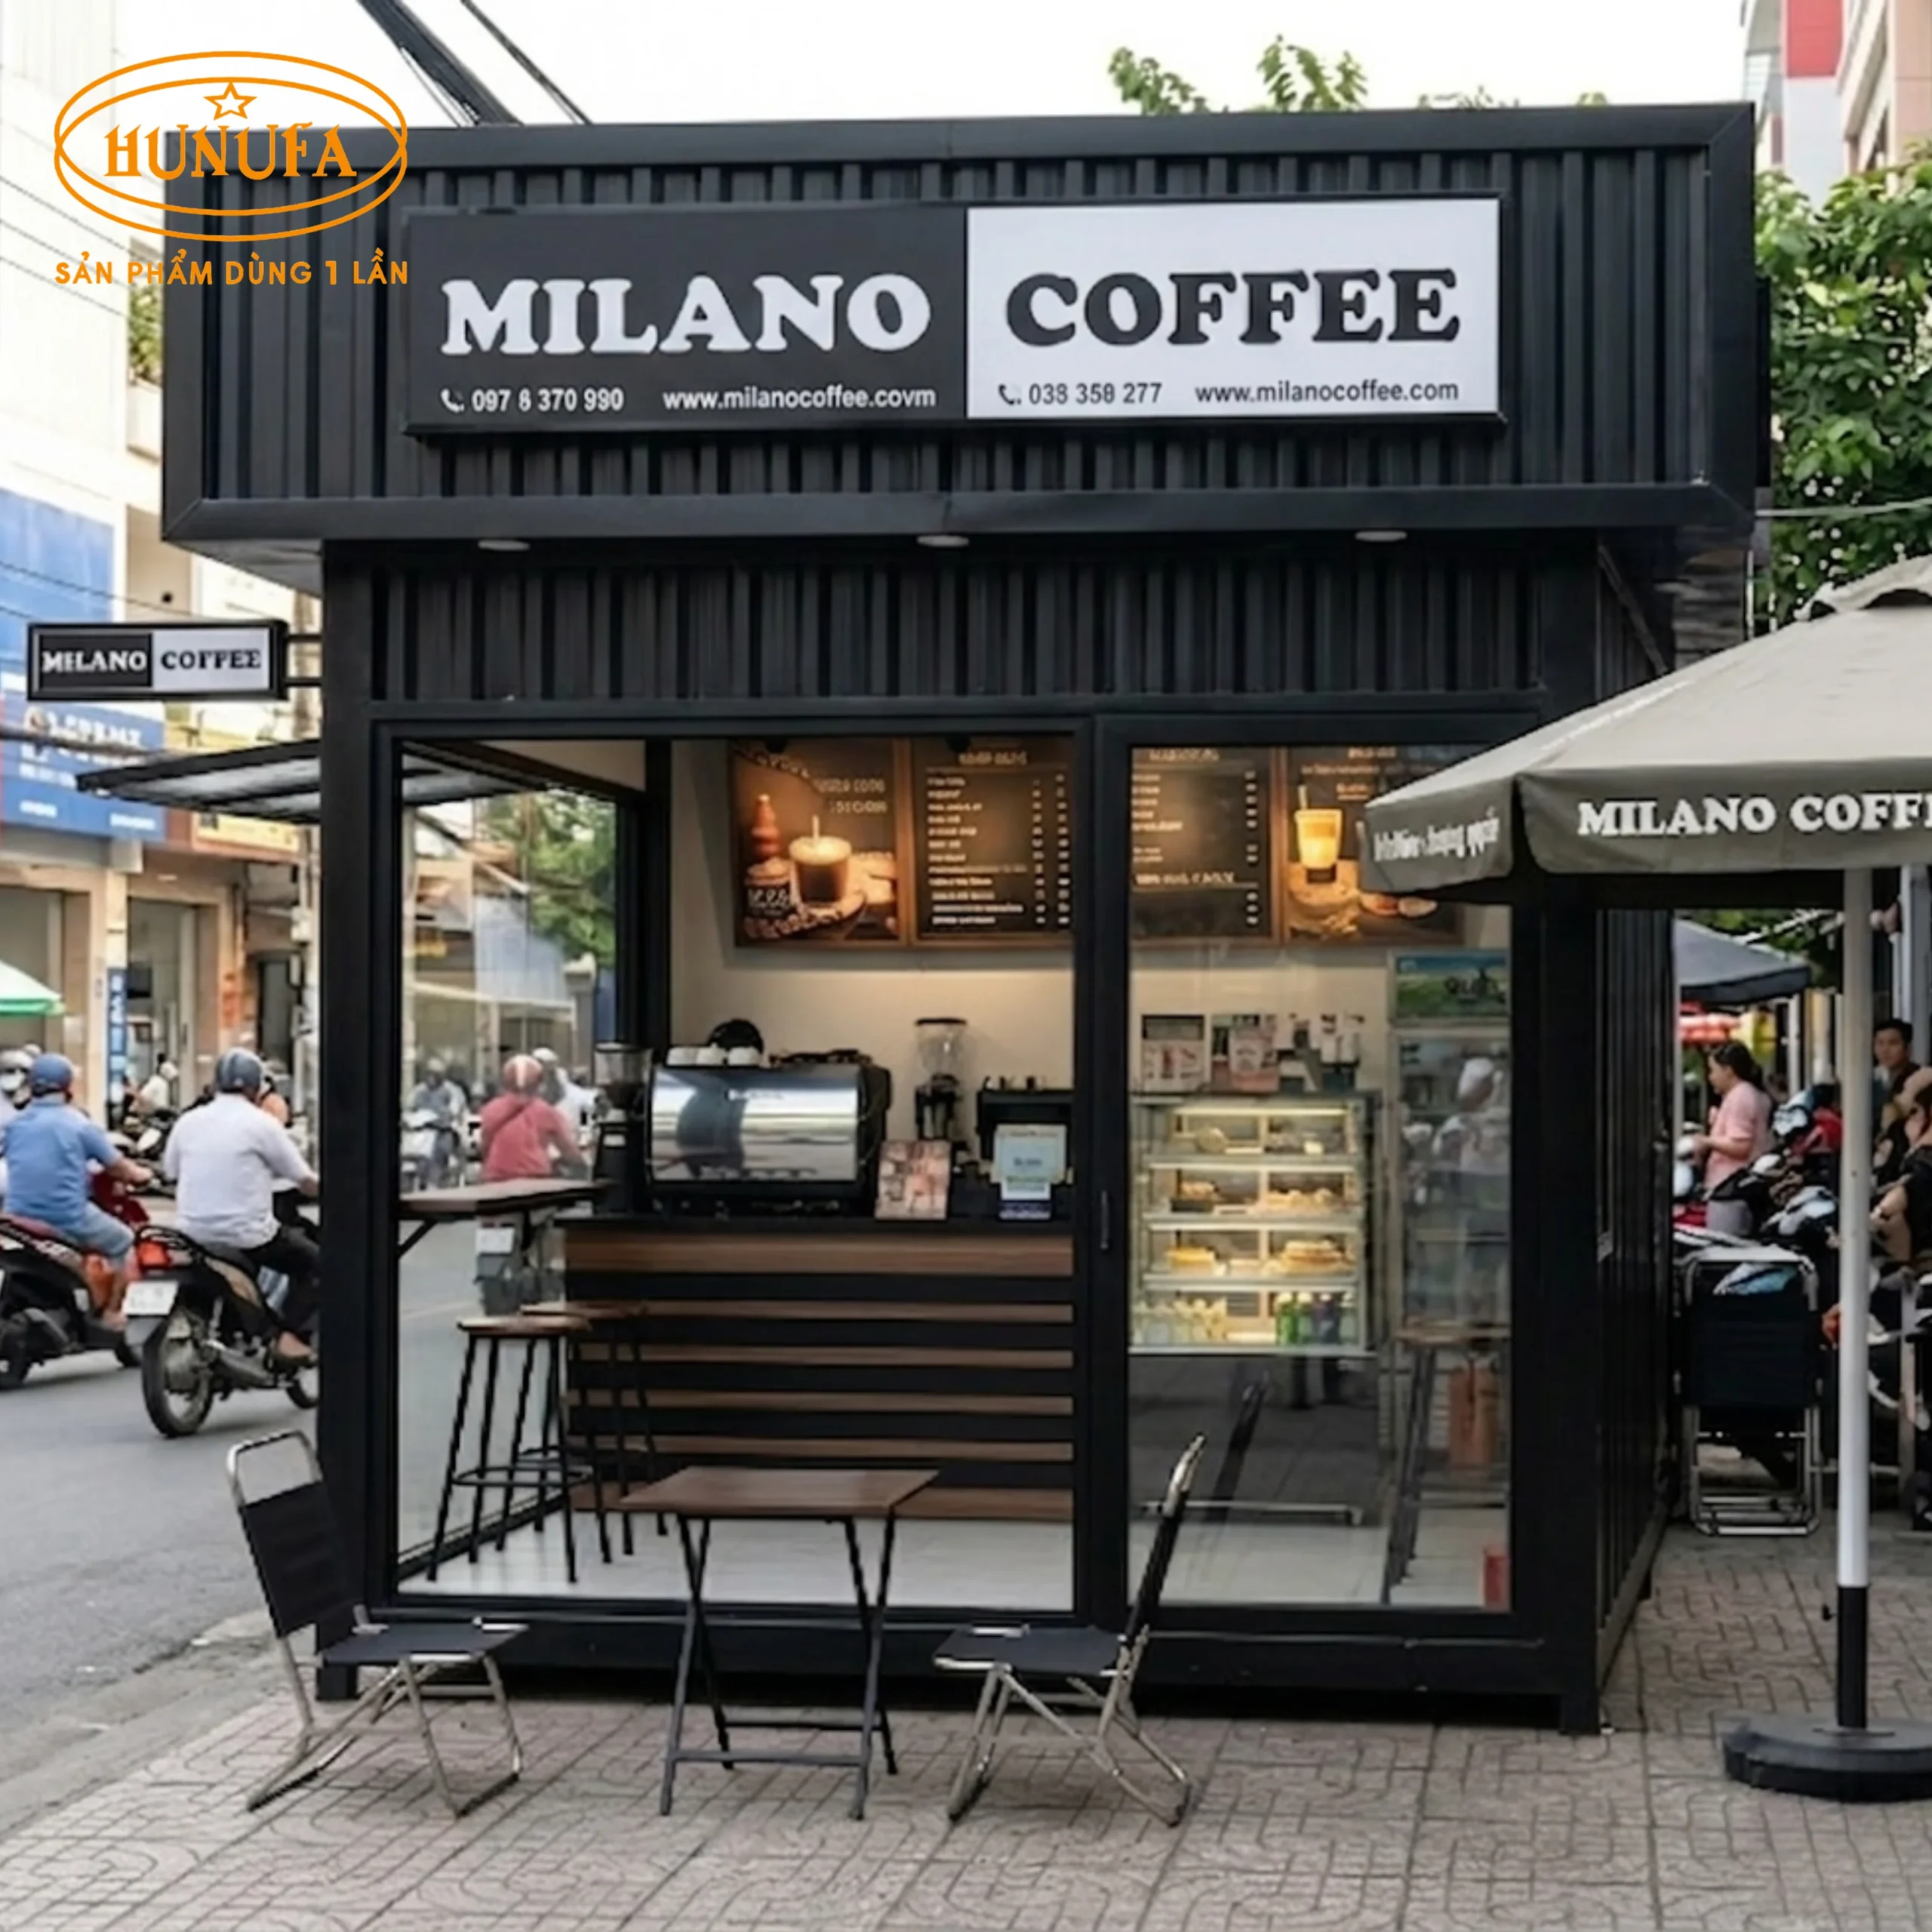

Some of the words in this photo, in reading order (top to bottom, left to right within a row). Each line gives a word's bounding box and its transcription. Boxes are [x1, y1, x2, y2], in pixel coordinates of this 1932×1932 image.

[441, 274, 931, 355] MILANO
[1006, 268, 1460, 348] COFFEE
[471, 388, 512, 413] 097
[537, 388, 577, 413] 370
[1123, 381, 1163, 404] 277
[1195, 379, 1460, 403] www.milanocoffee.com
[1577, 796, 1777, 835] MILANO
[1789, 792, 1932, 832] COFF
